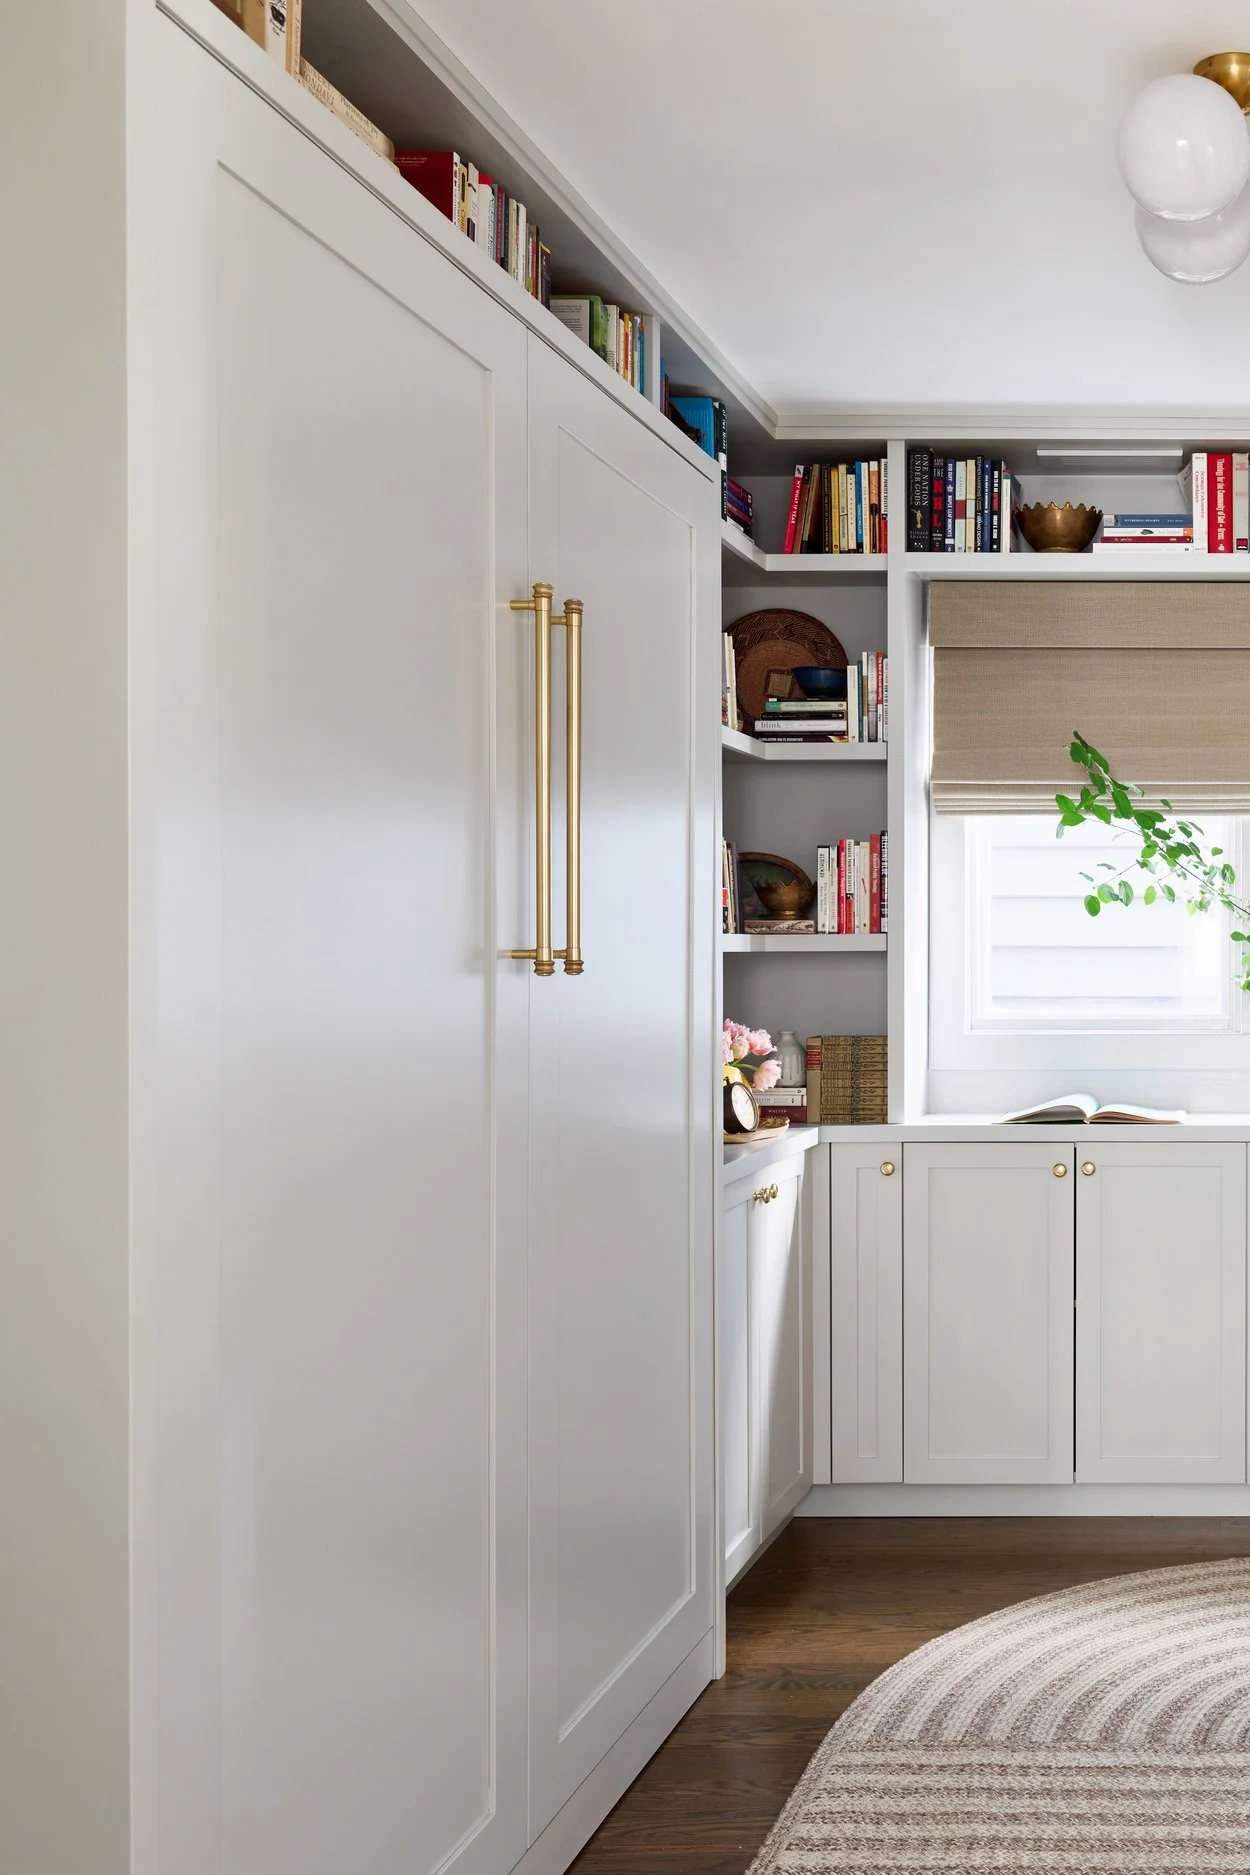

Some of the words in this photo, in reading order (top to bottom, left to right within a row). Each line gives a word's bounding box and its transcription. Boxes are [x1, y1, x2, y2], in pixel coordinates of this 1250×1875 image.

[914, 454, 922, 482] UNDER
[921, 454, 929, 472] ONE
[933, 468, 944, 478] THE
[1216, 459, 1225, 476] Theology
[797, 480, 801, 489] MY
[914, 484, 922, 506] GODS
[921, 474, 929, 506] NATION
[933, 479, 944, 527] NHL
[1216, 490, 1225, 511] Community
